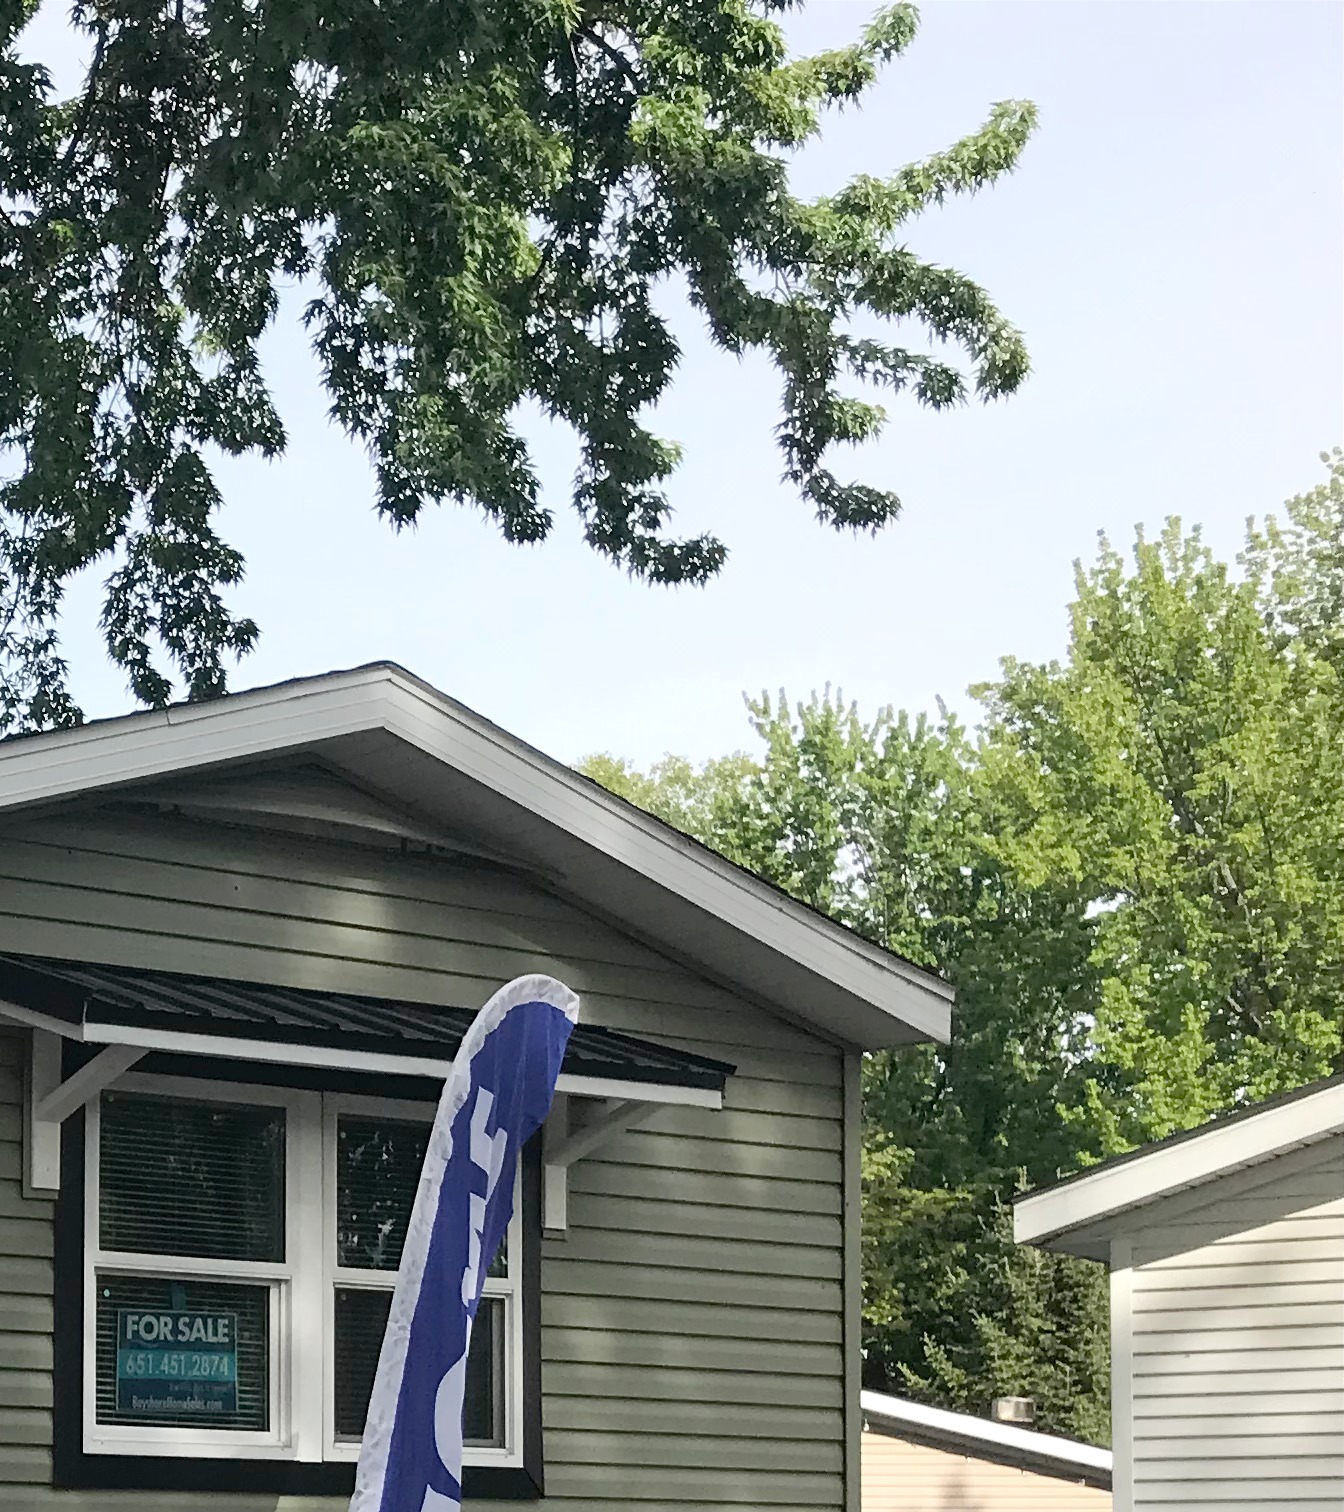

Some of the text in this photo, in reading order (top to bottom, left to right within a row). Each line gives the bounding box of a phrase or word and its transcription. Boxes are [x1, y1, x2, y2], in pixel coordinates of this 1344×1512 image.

[126, 1314, 230, 1343] FOR SALE
[125, 1353, 229, 1377] 651.451.2874
